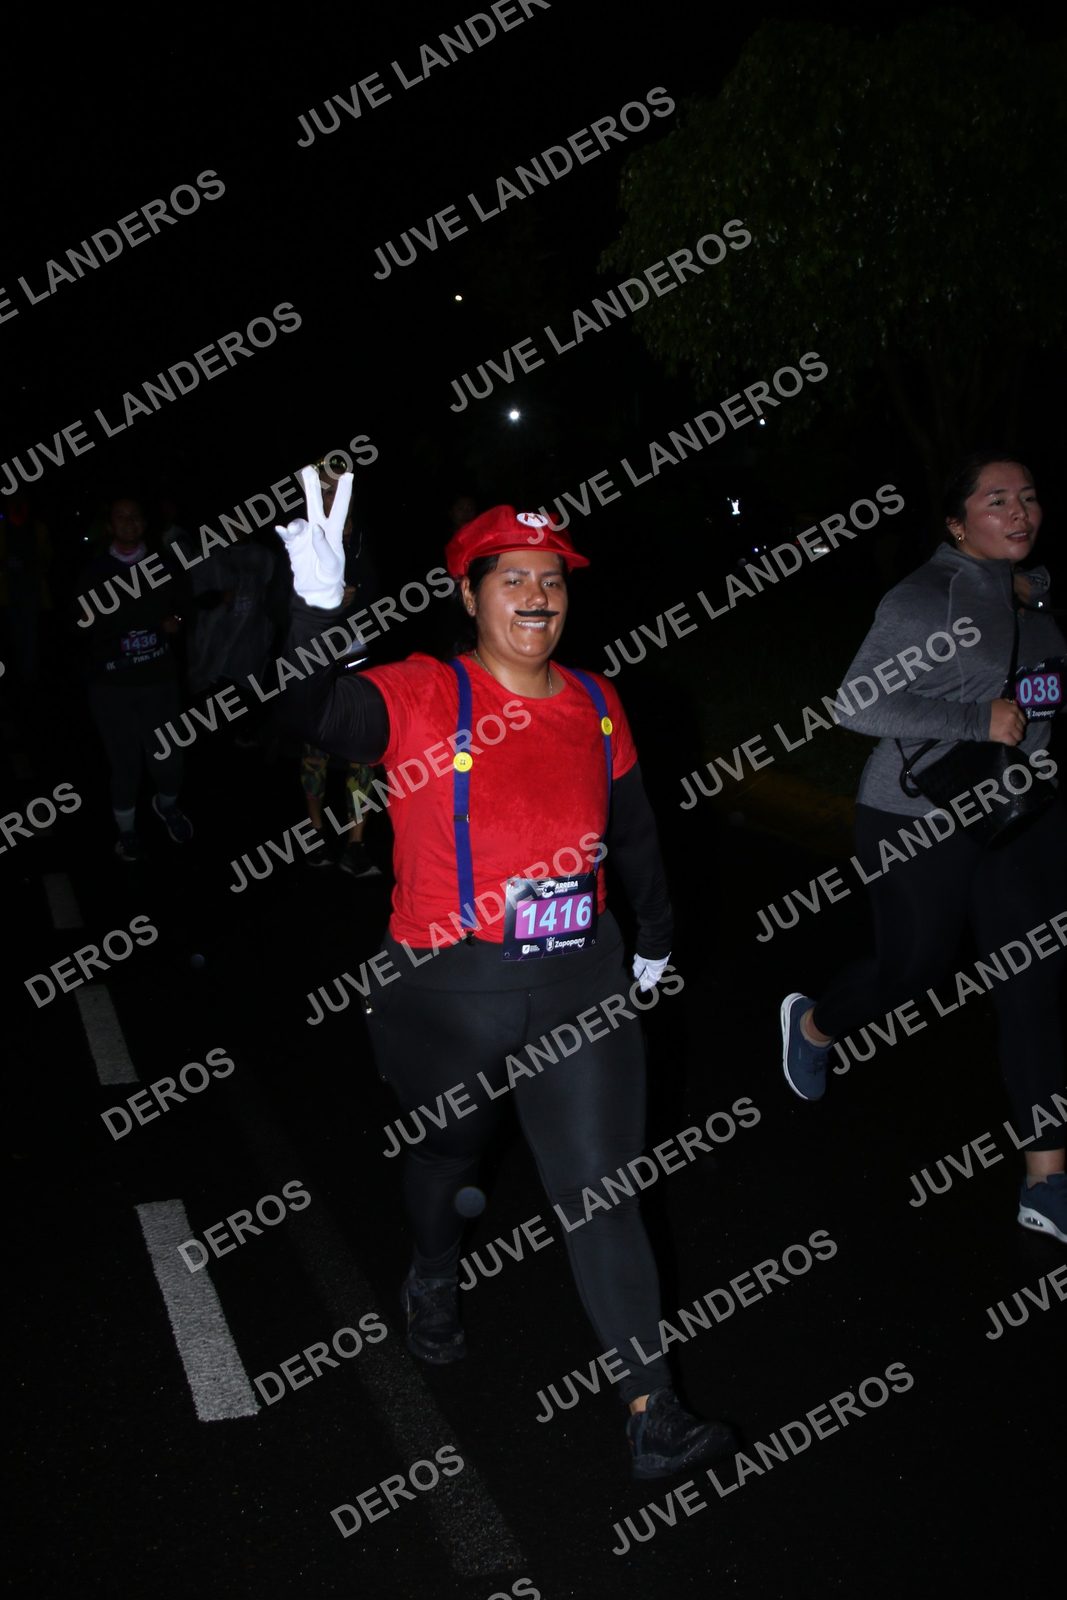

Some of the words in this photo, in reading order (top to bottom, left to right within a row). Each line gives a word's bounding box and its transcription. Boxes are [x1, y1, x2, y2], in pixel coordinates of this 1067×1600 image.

[122, 632, 158, 651] 1436
[1020, 675, 1060, 704] 038
[522, 895, 592, 935] 1416
[554, 938, 585, 948] Zapopan
